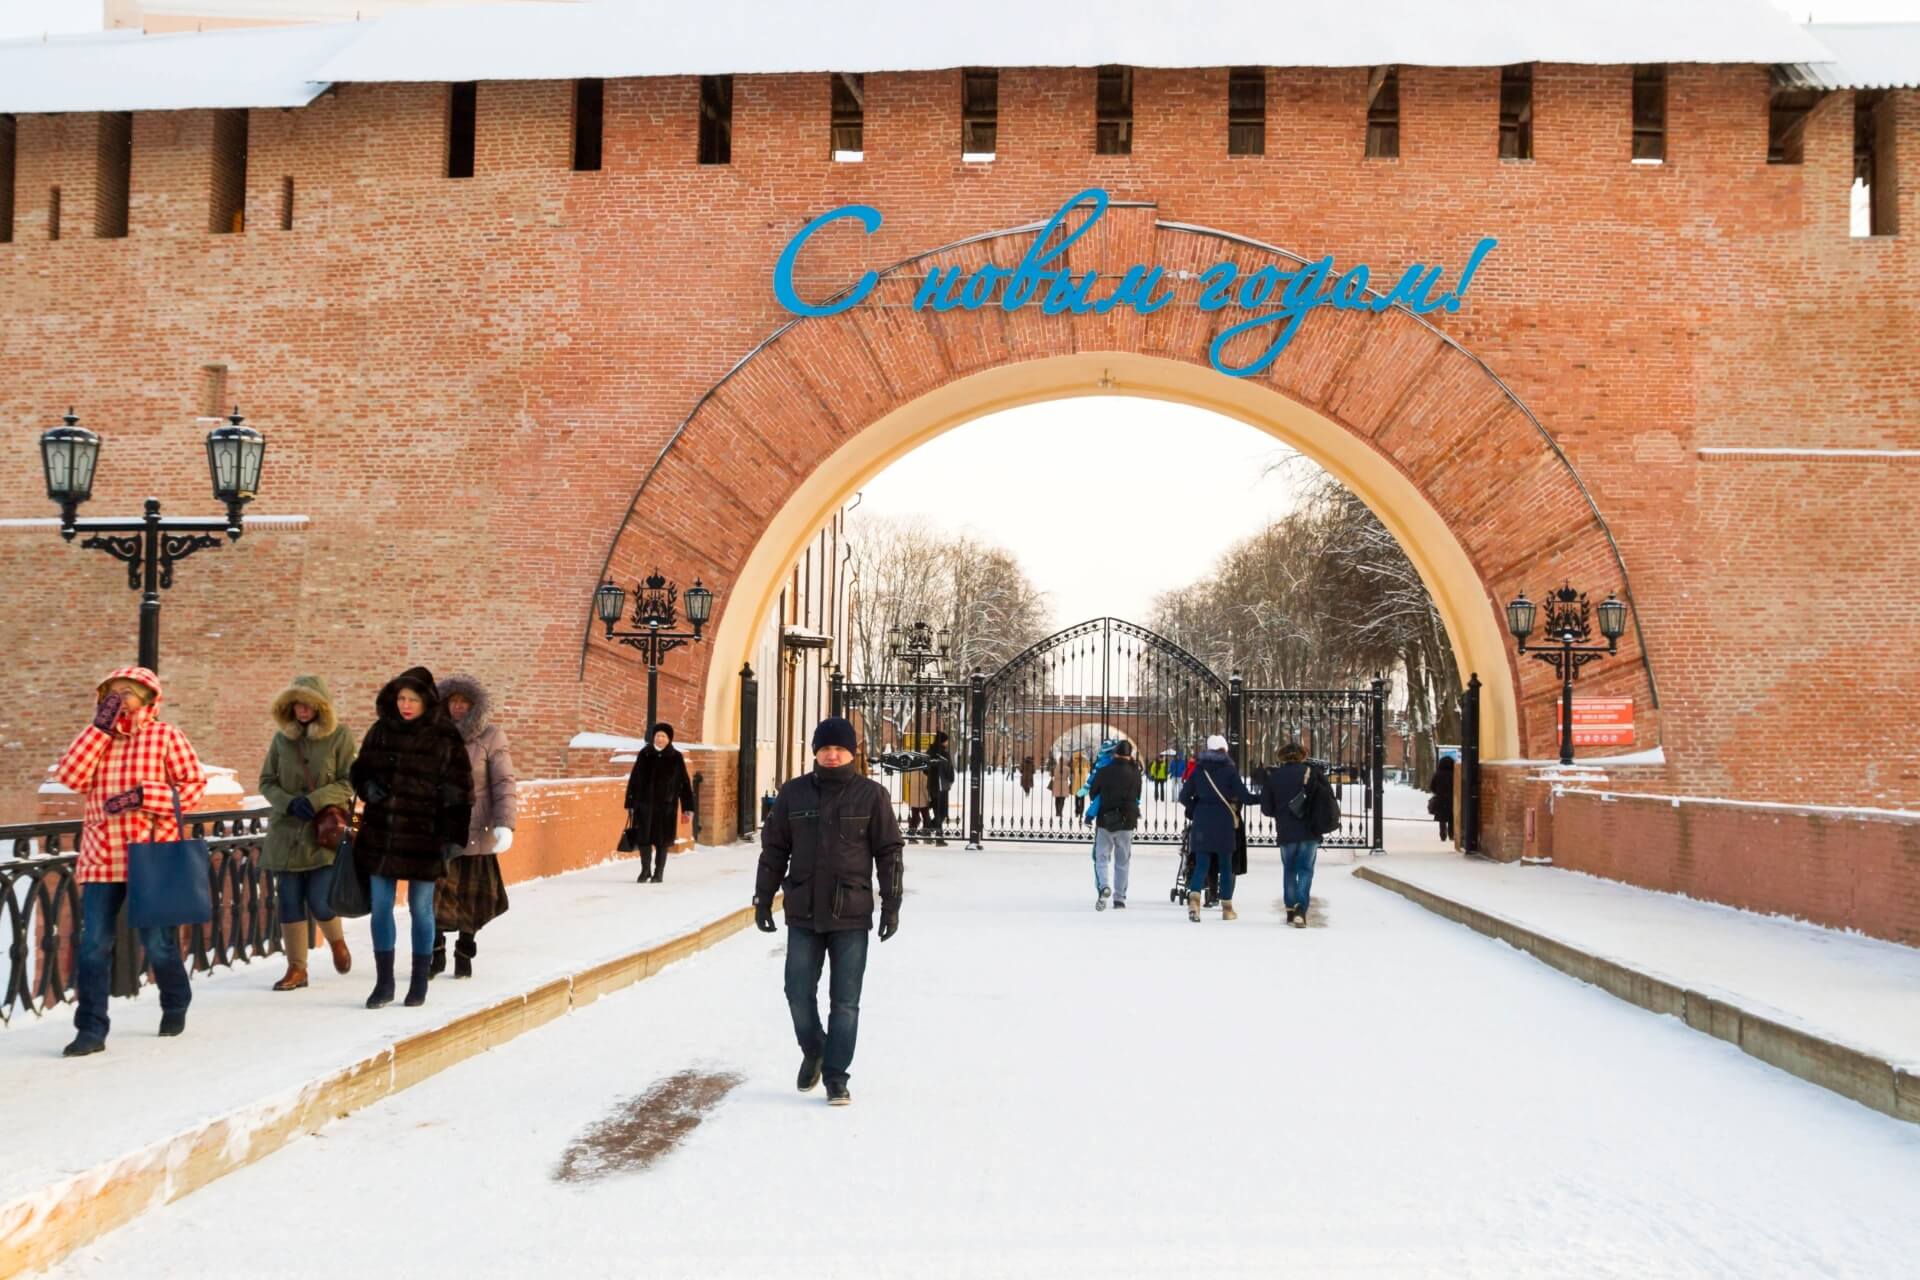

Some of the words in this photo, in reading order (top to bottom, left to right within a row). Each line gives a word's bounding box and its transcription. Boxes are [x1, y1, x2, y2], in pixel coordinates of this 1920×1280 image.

[773, 204, 883, 317] С
[913, 187, 1174, 315] новым
[1199, 237, 1498, 378] годом!
